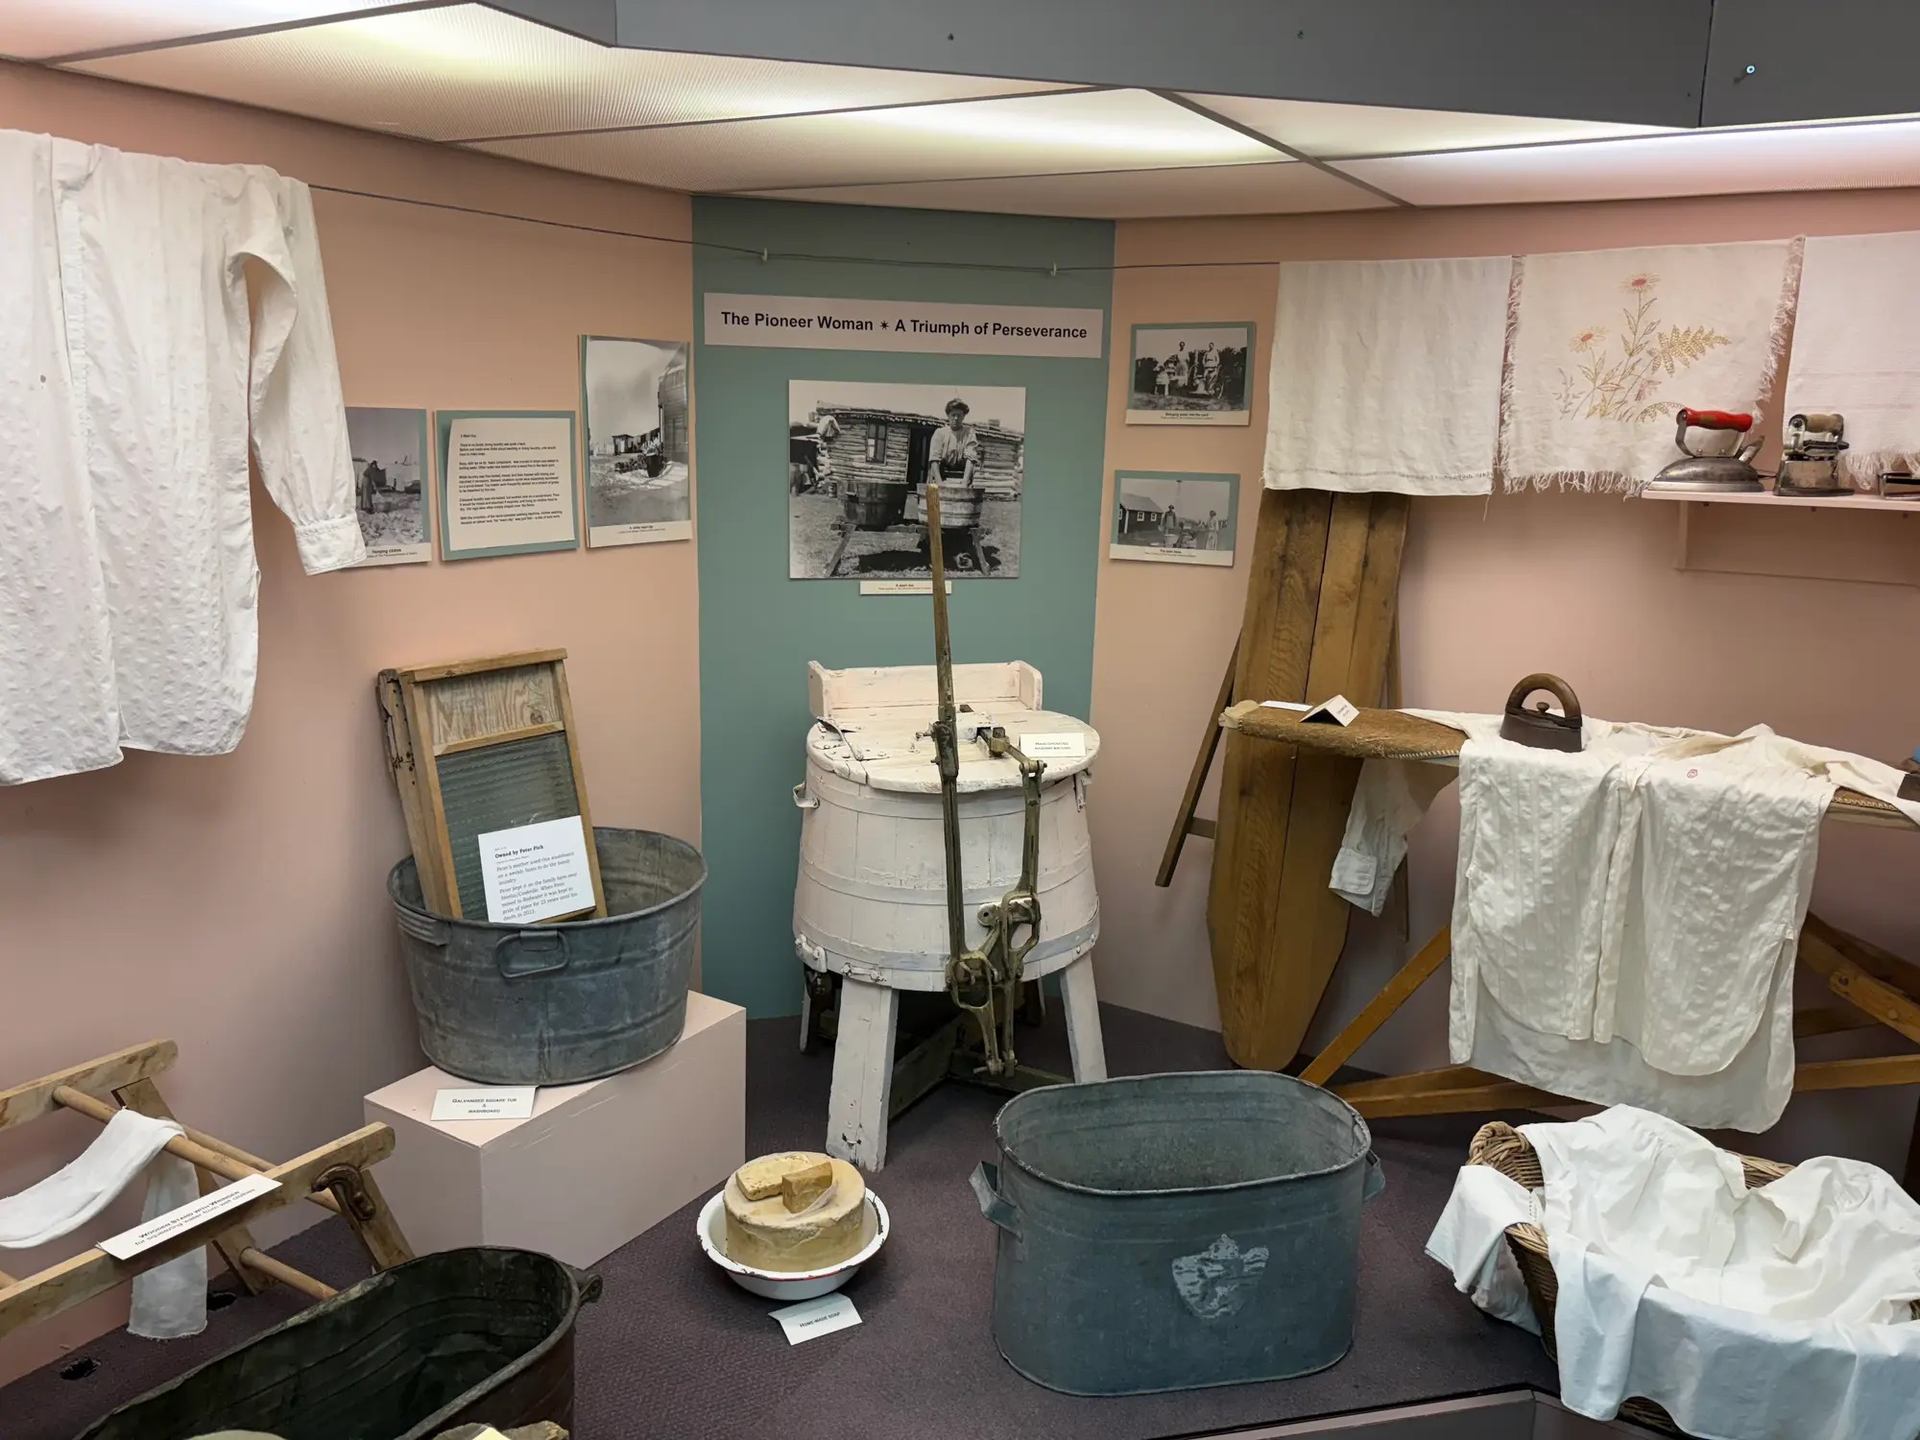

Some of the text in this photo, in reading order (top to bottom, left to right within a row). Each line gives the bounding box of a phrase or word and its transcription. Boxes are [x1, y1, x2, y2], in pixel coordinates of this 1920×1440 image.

[721, 311, 1087, 339] The Pioneer Woman A Triumph of Perseverance
